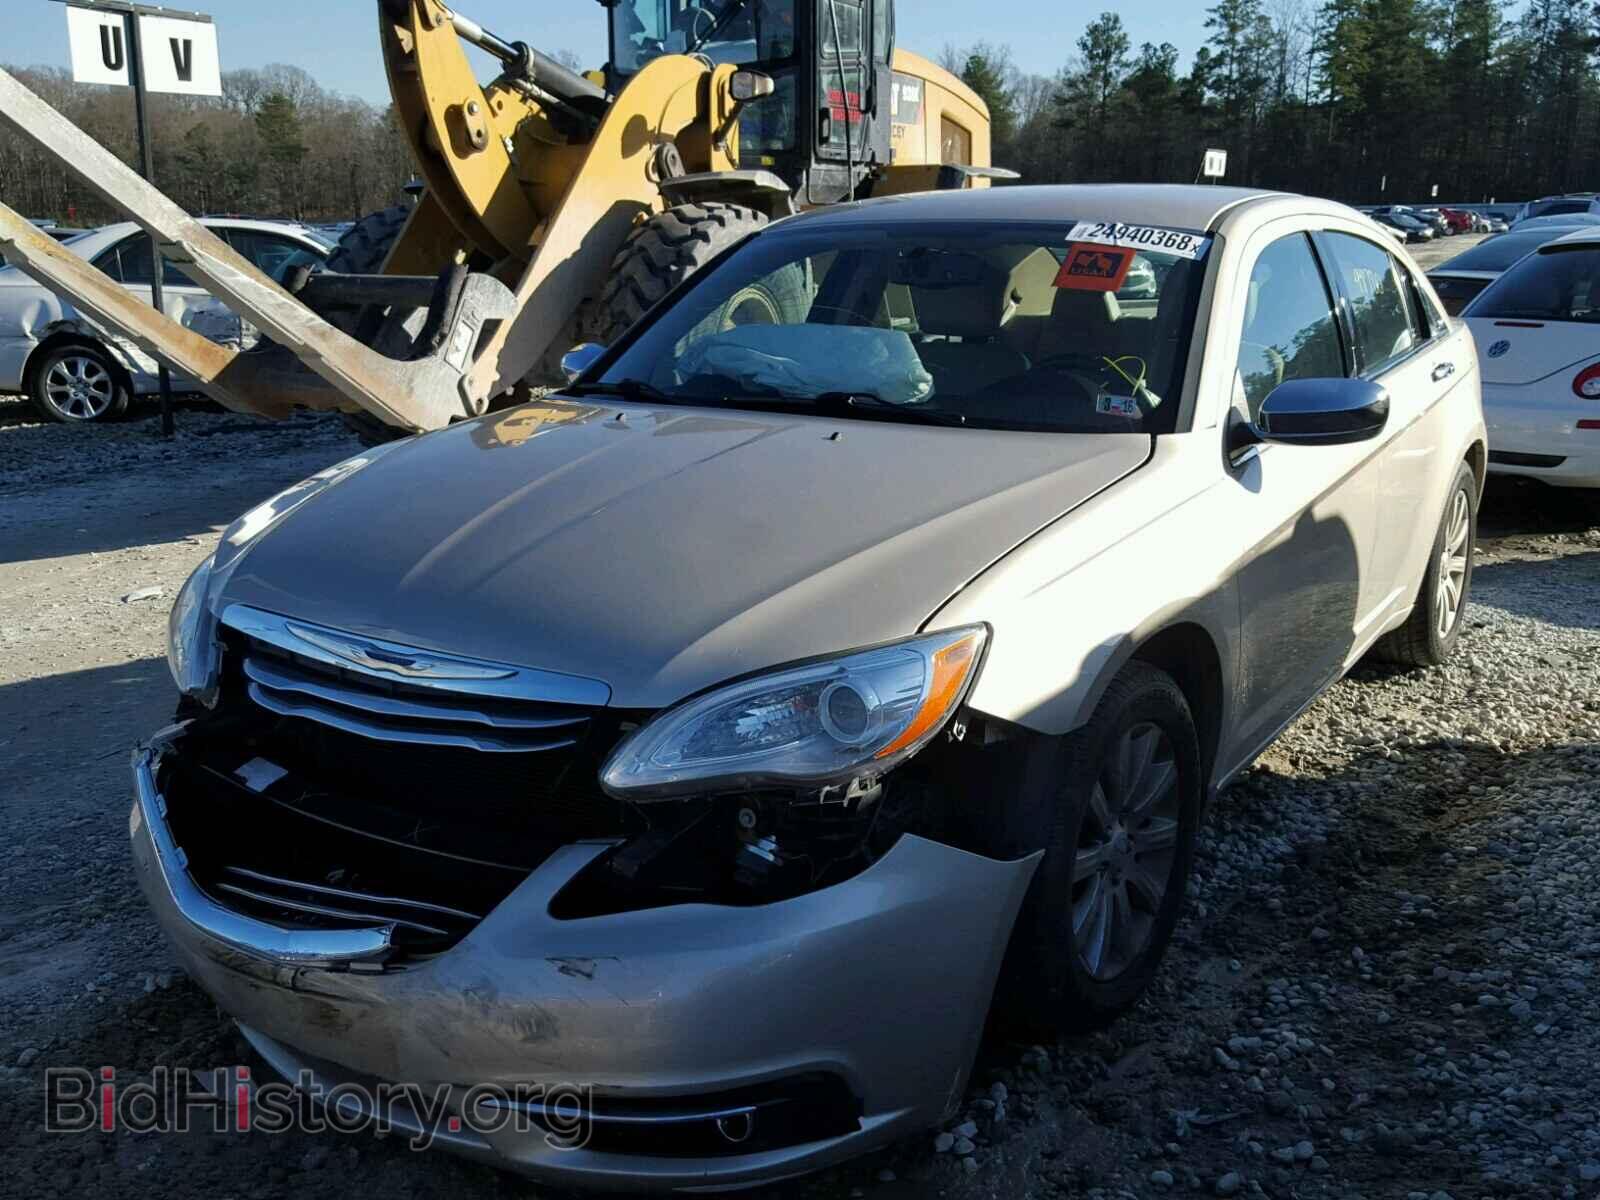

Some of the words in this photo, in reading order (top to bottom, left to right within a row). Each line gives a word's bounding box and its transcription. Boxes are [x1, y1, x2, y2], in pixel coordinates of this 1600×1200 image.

[99, 24, 124, 71] U
[169, 37, 192, 82] V
[1088, 223, 1193, 252] 24940368
